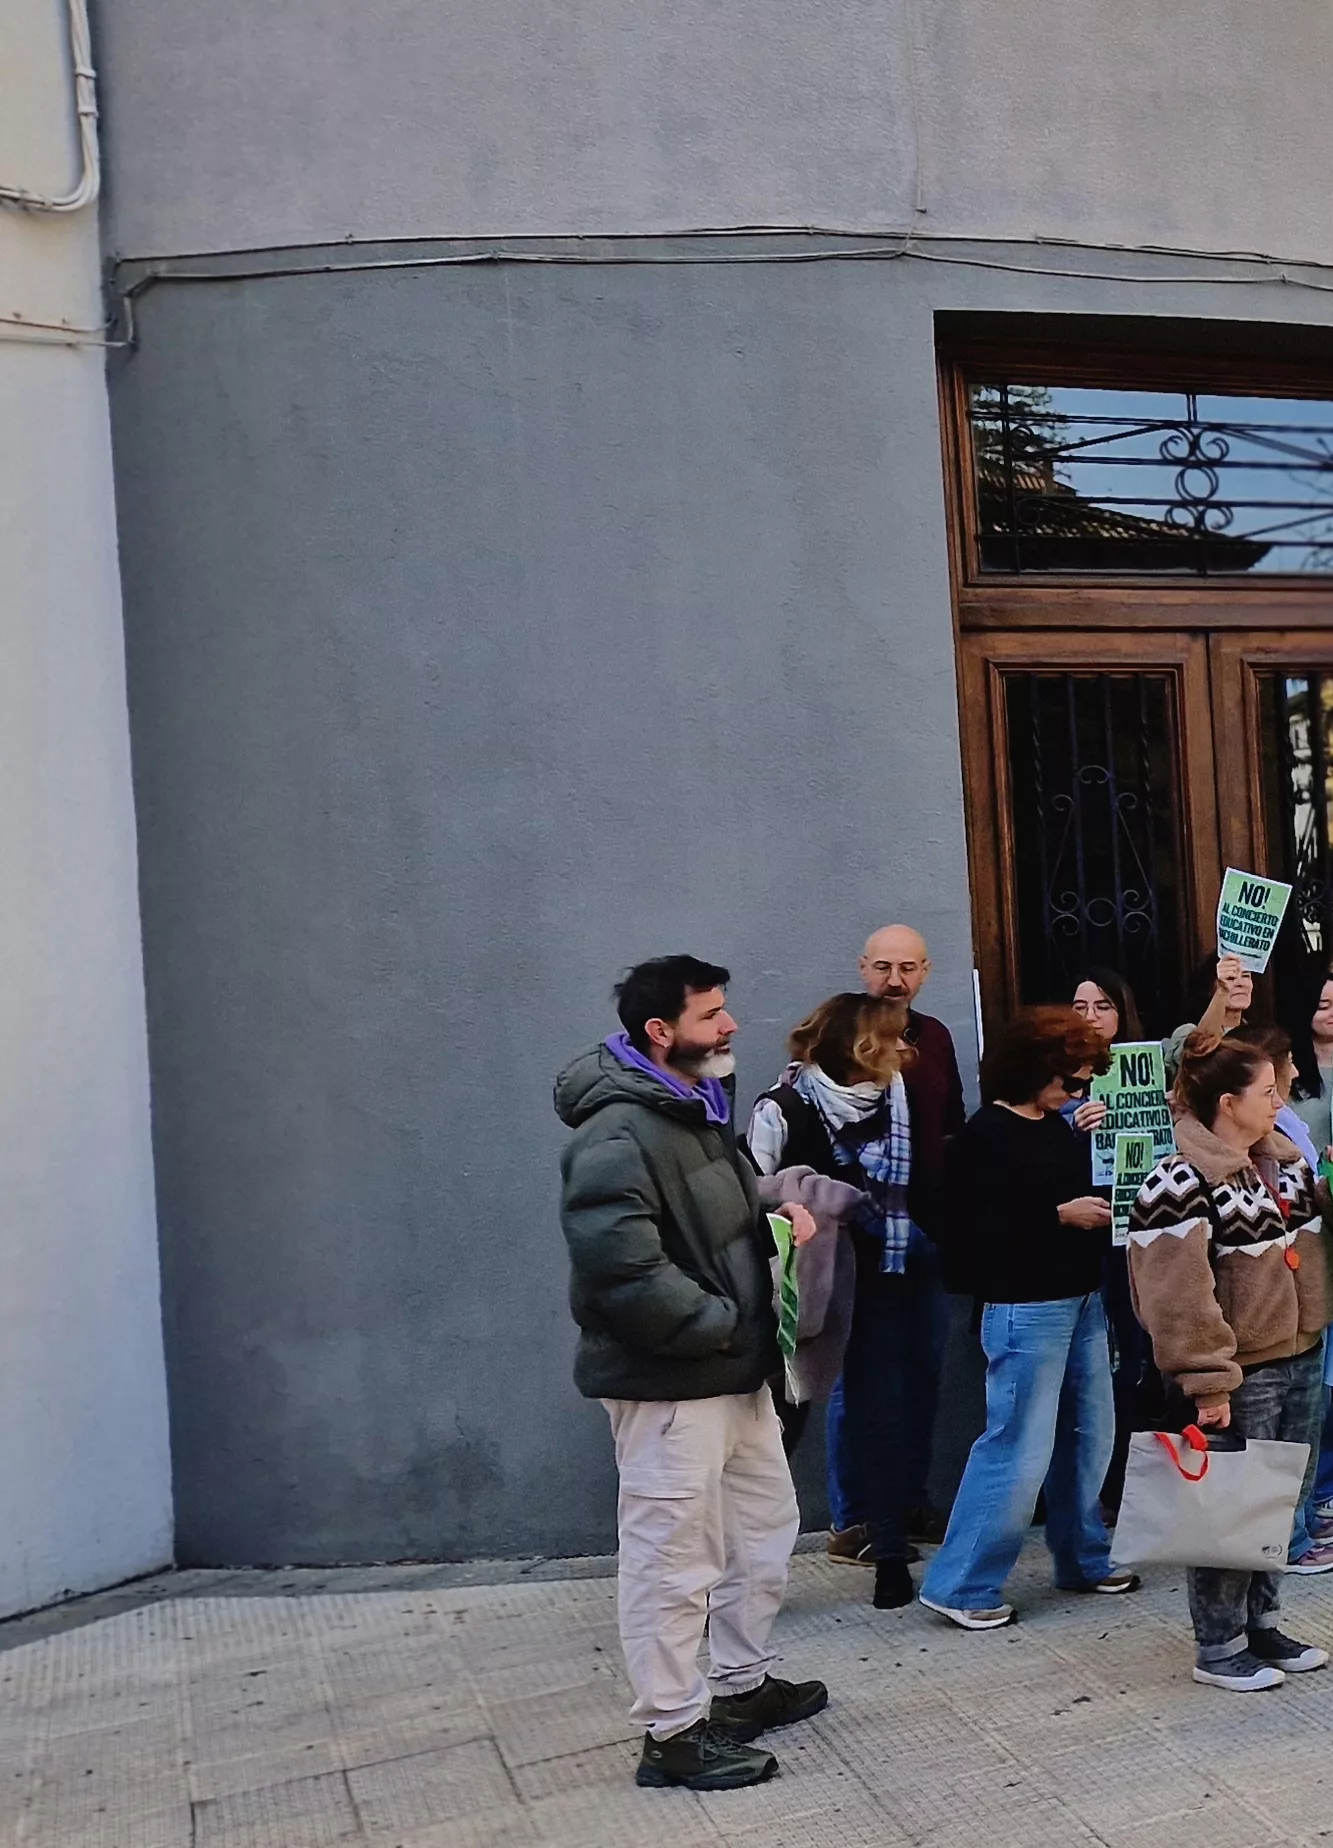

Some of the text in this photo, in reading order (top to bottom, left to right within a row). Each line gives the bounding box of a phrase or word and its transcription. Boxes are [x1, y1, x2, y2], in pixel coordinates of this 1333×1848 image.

[1238, 880, 1271, 910] NO!
[1231, 904, 1280, 927] CONCIERTO
[1262, 925, 1276, 939] EN
[1120, 1053, 1156, 1087] NO!
[1125, 1142, 1145, 1169] NO!
